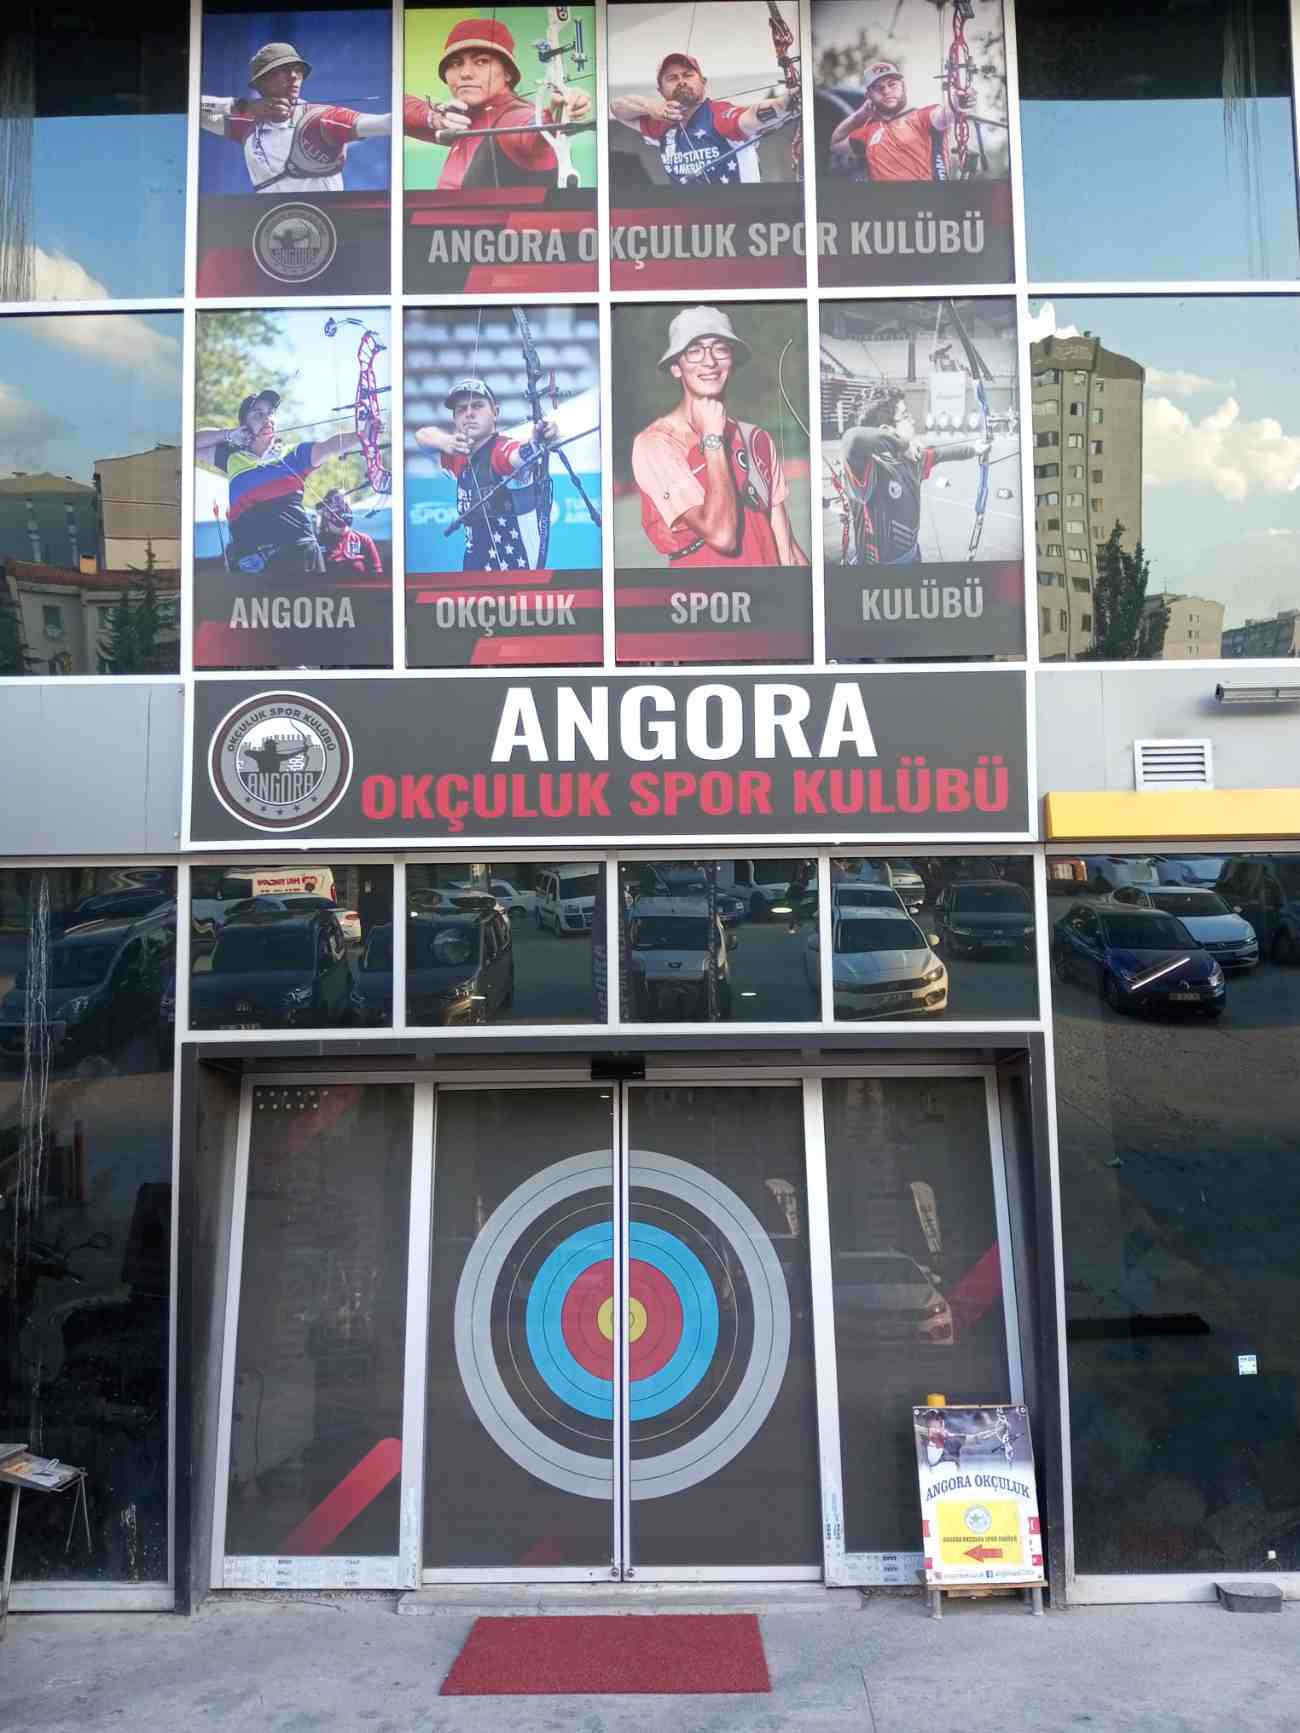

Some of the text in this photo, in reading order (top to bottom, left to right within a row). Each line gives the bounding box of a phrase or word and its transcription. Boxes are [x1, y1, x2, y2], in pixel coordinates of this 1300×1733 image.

[428, 211, 984, 270] ANGORA OKÇULUK SPOR KULÜBÜ
[229, 578, 984, 637] ANGORA OKÇULUK SPOR KULÜBÜ
[269, 707, 301, 717] SPOR
[490, 683, 878, 763] ANGORA
[247, 772, 315, 802] ANGORA
[361, 756, 1009, 832] OKÇULUK SPOR KULÜBÜ
[926, 1474, 1030, 1501] ANGORA OKÇULUK
